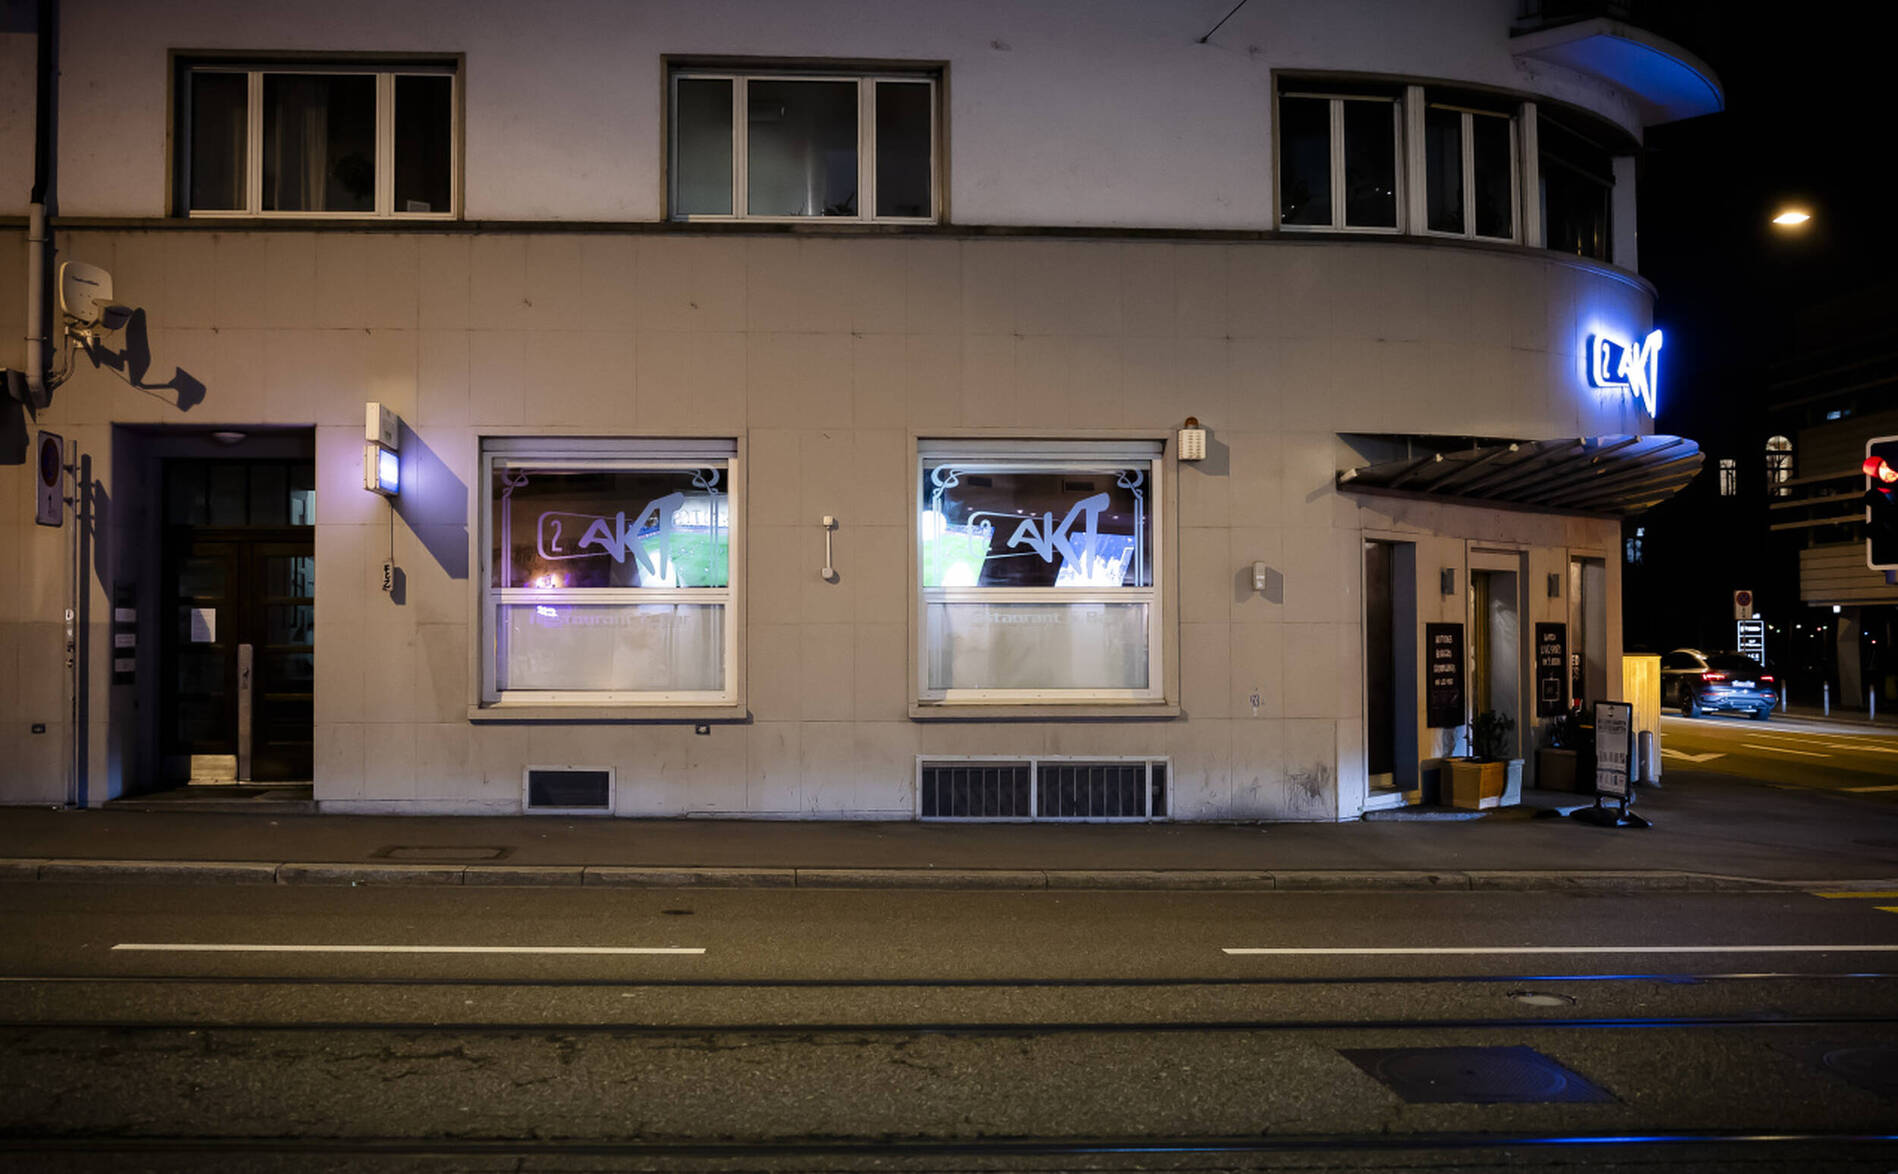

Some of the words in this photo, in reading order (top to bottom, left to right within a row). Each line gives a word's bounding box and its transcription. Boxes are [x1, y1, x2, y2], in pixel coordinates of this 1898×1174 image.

[550, 519, 562, 552] 2
[578, 492, 685, 581] AKT
[1006, 492, 1110, 579] AKT
